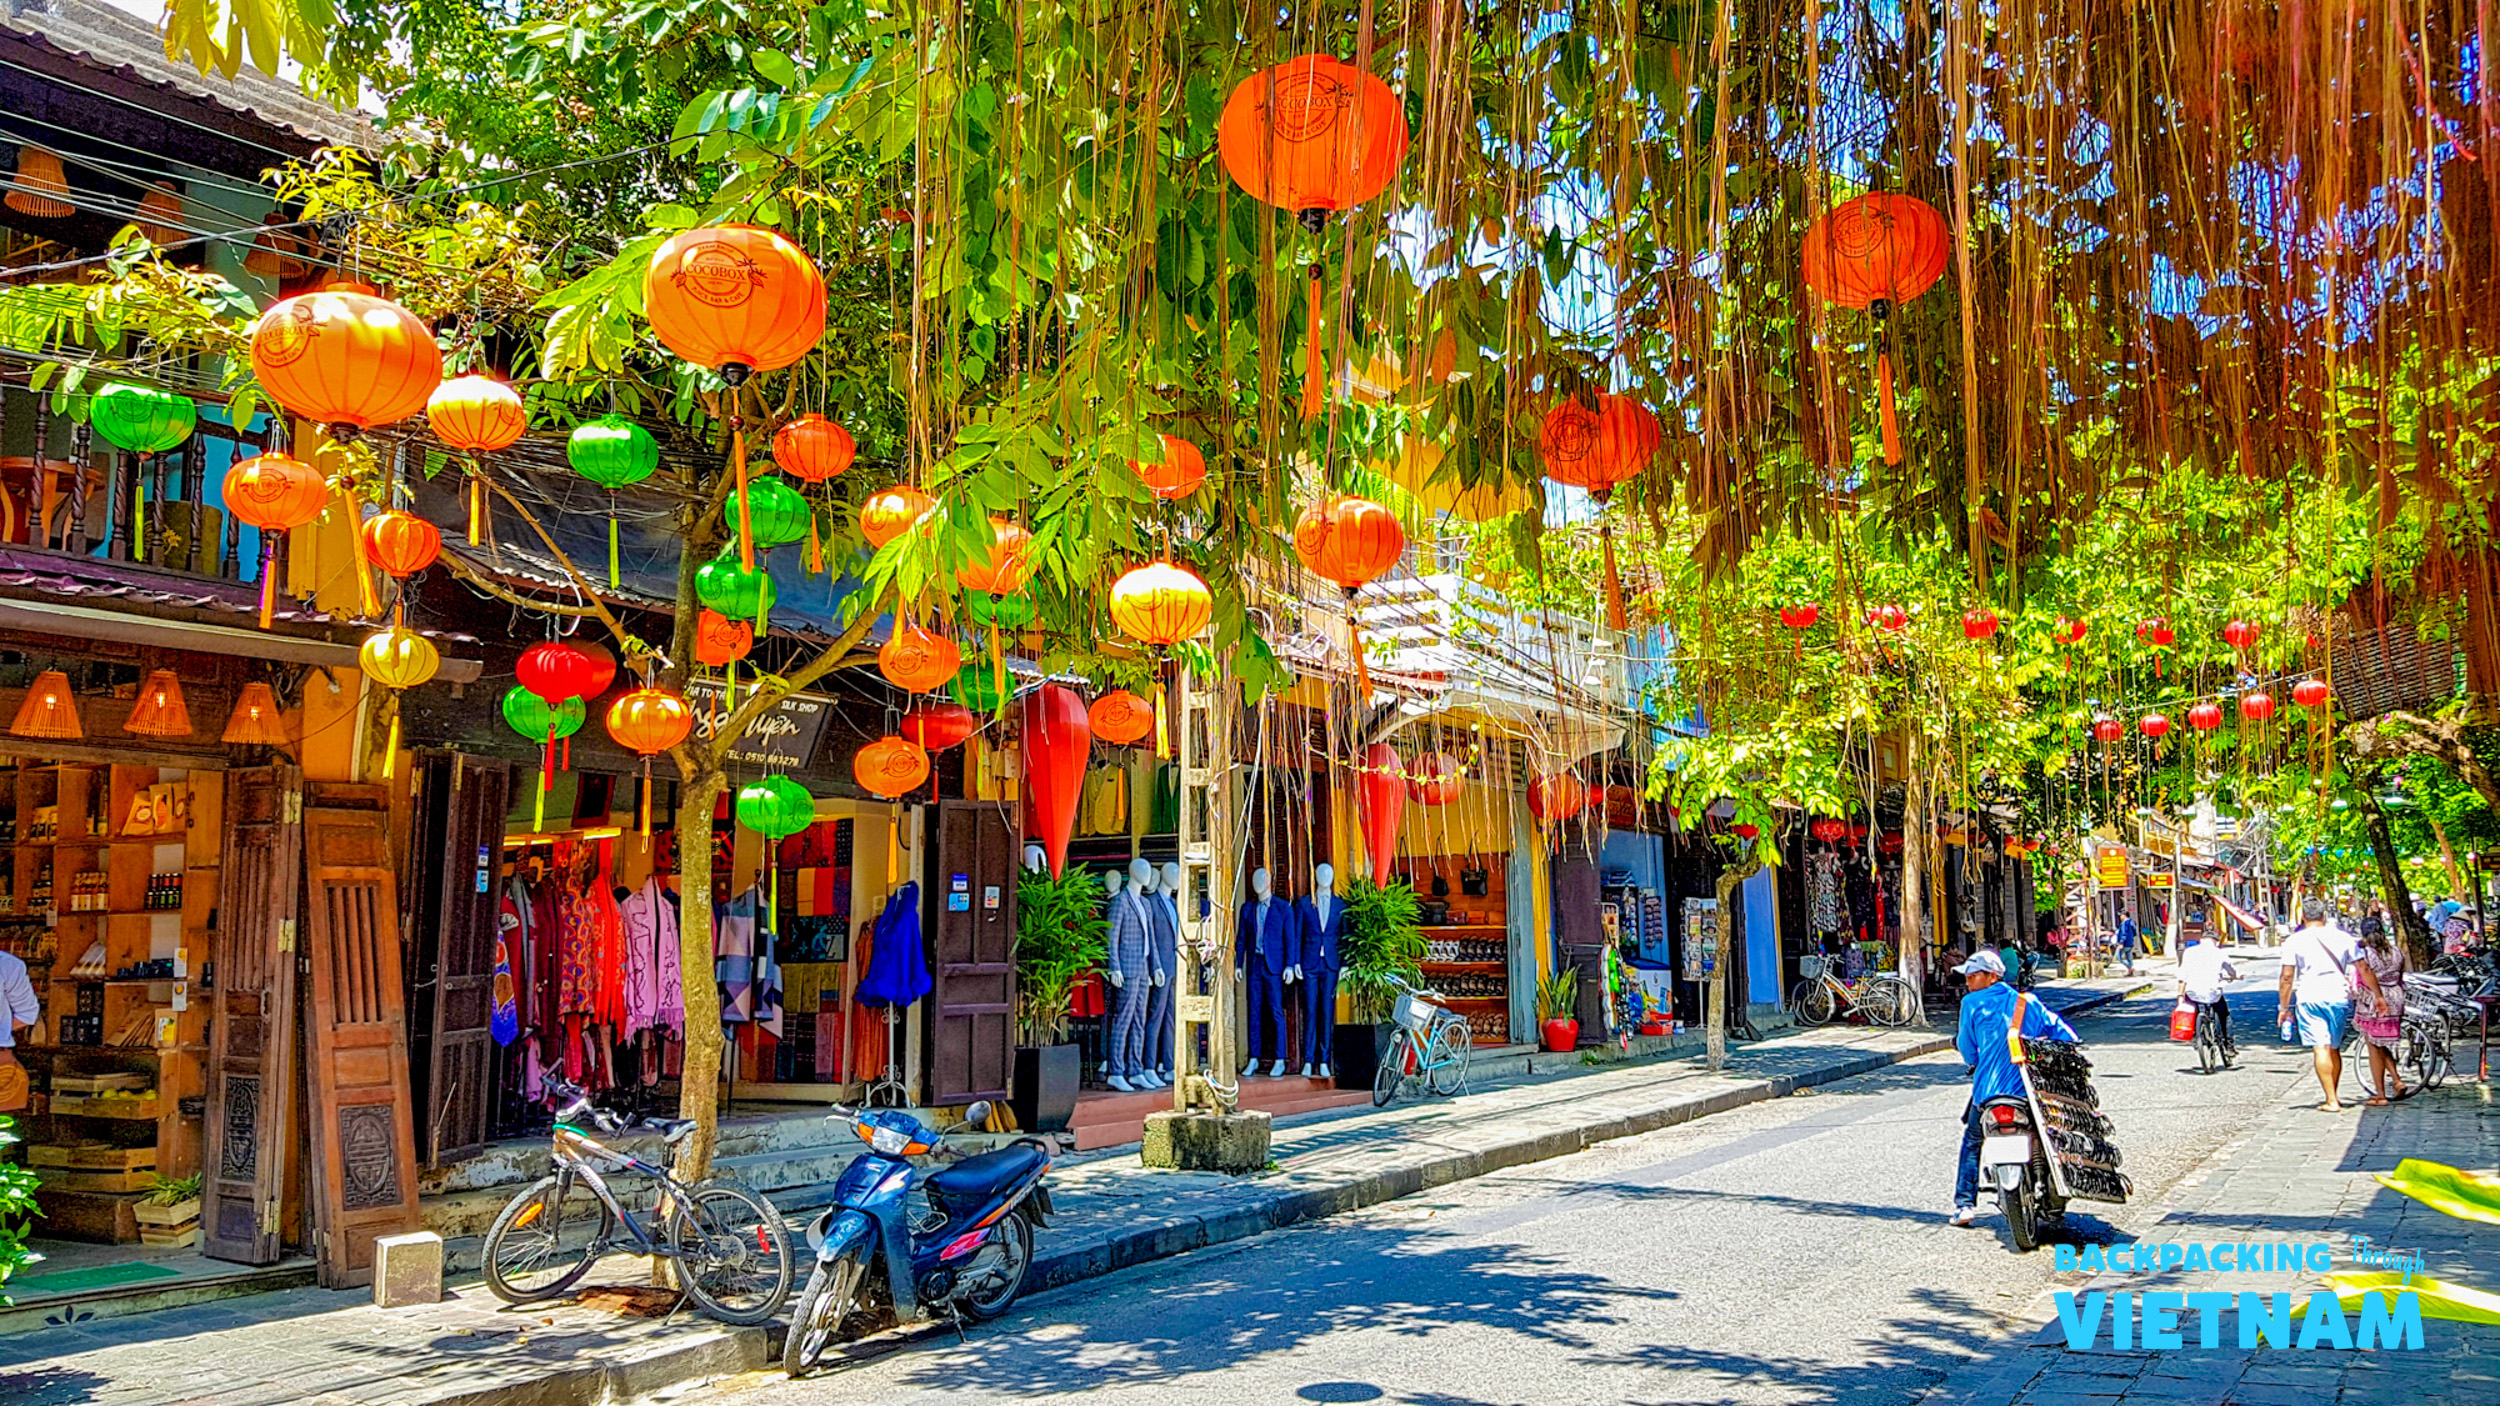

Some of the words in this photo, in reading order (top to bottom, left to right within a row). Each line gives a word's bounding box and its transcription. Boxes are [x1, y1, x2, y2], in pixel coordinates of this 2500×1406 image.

[686, 263, 746, 281] COCOBOX
[780, 700, 797, 711] SILK
[797, 702, 819, 713] SHOP
